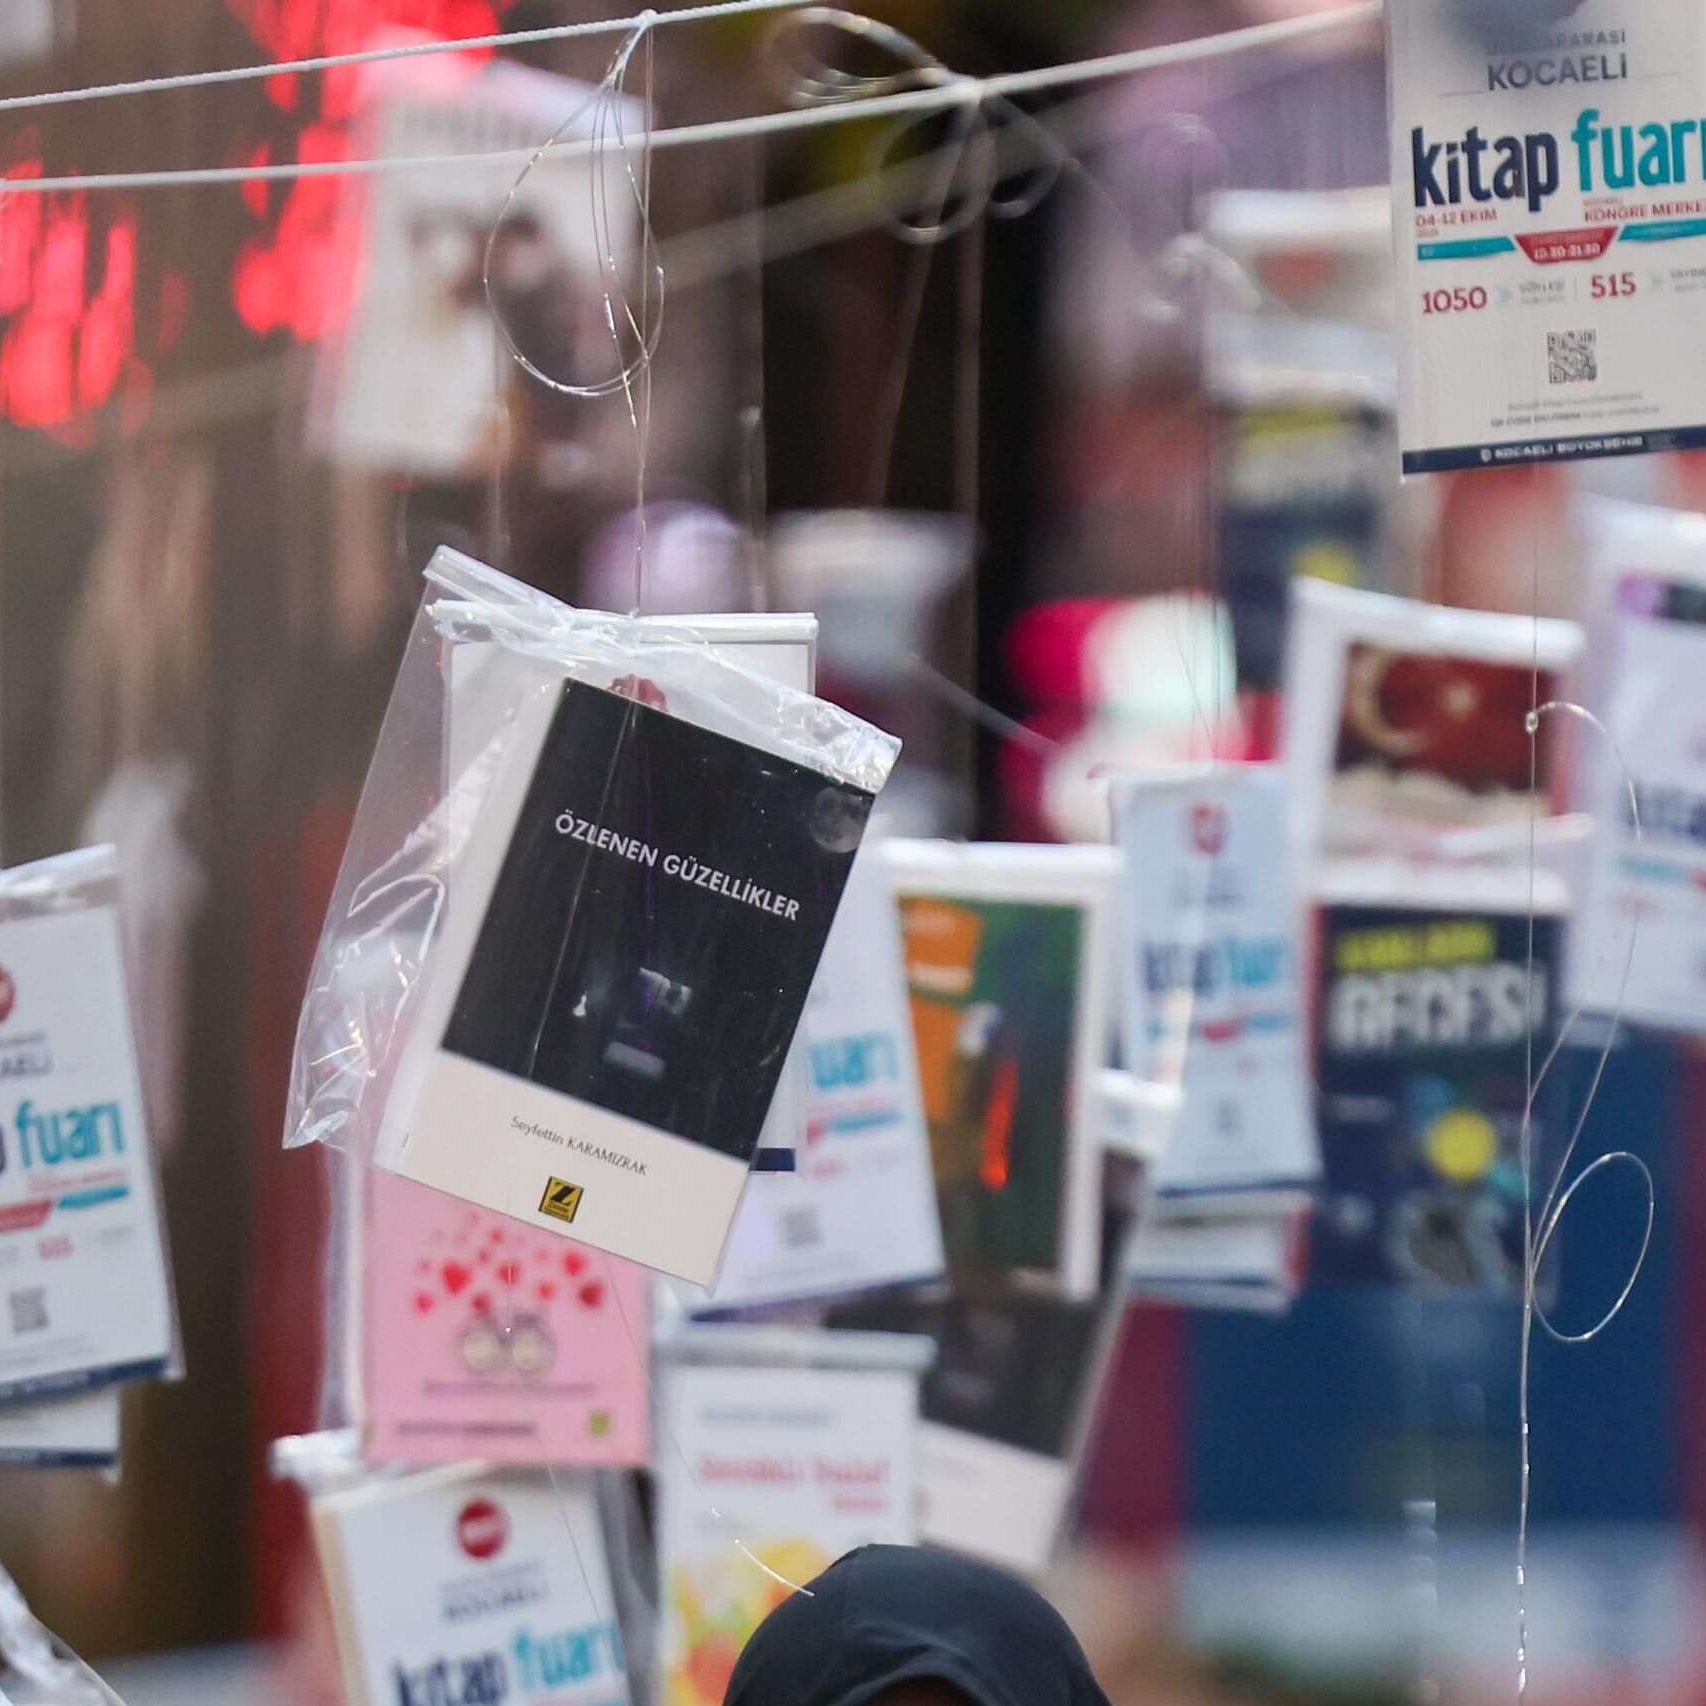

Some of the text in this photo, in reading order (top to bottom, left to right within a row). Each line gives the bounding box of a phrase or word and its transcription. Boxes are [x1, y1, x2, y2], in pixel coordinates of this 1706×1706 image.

[1412, 126, 1560, 213] kitap
[1421, 285, 1488, 315] 1050
[1590, 271, 1636, 299] 515
[555, 808, 801, 922] ÖZLENEN GÜZELLİKLER
[511, 1115, 649, 1177] Seyfettin KARAMIZRAK
